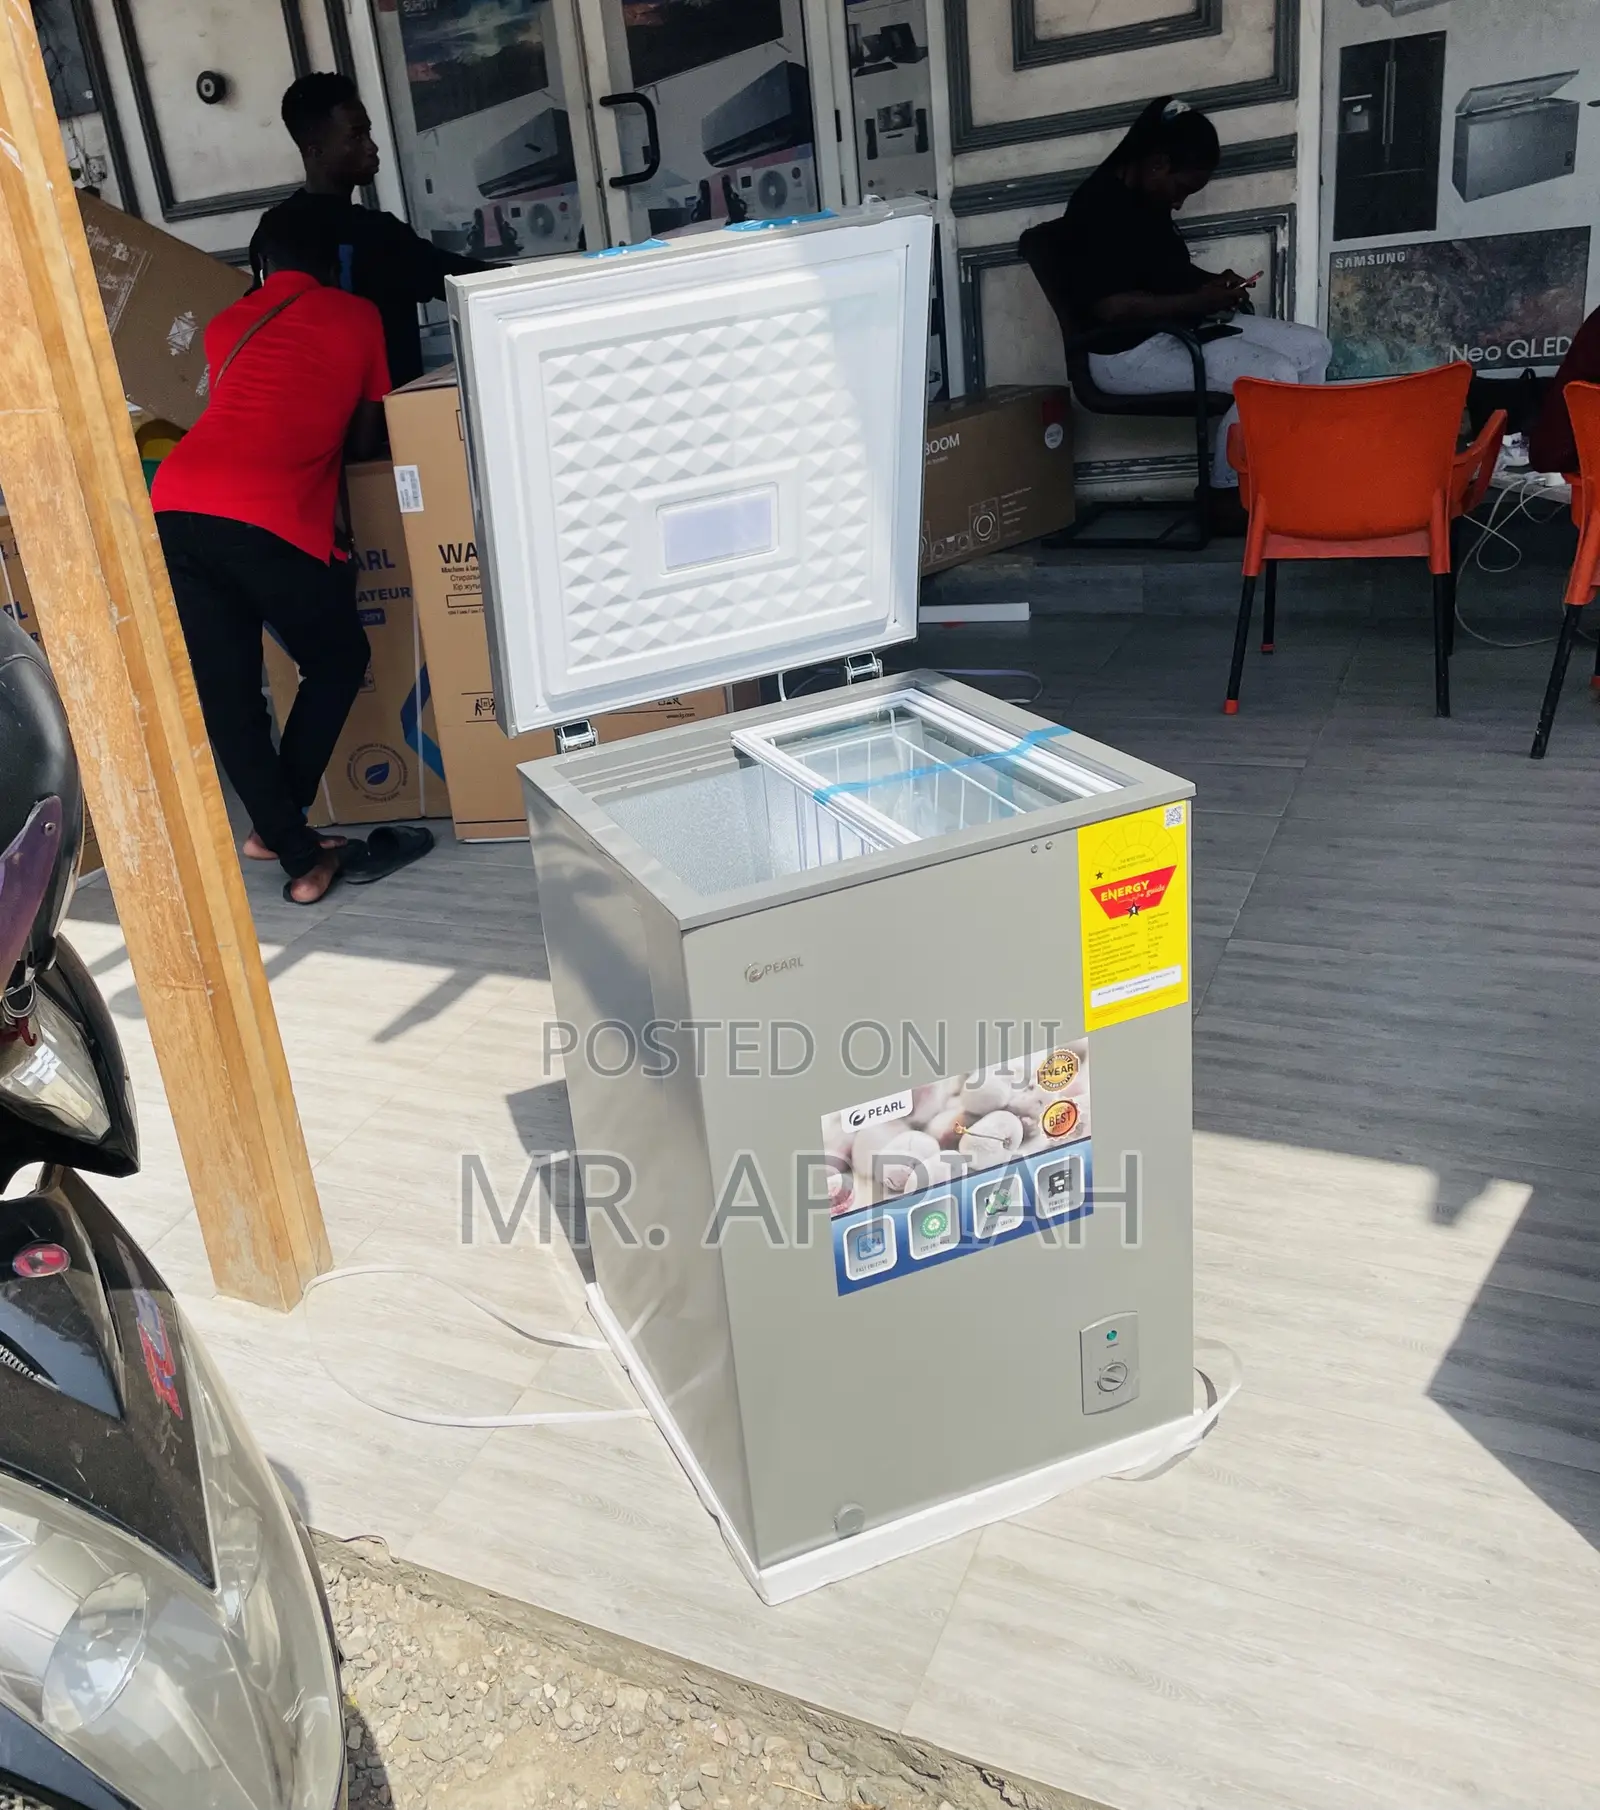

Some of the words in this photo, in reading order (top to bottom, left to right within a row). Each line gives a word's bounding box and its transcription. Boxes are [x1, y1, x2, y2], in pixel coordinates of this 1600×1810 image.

[1335, 251, 1406, 269] SAMSUNG
[1449, 345, 1502, 363] Neo
[1506, 335, 1573, 360] QLED
[1101, 880, 1150, 902] ENERGY
[764, 956, 804, 976] PEARL
[1048, 1063, 1074, 1078] YEAR
[868, 1100, 906, 1119] PEARL
[1049, 1111, 1072, 1127] BEST
